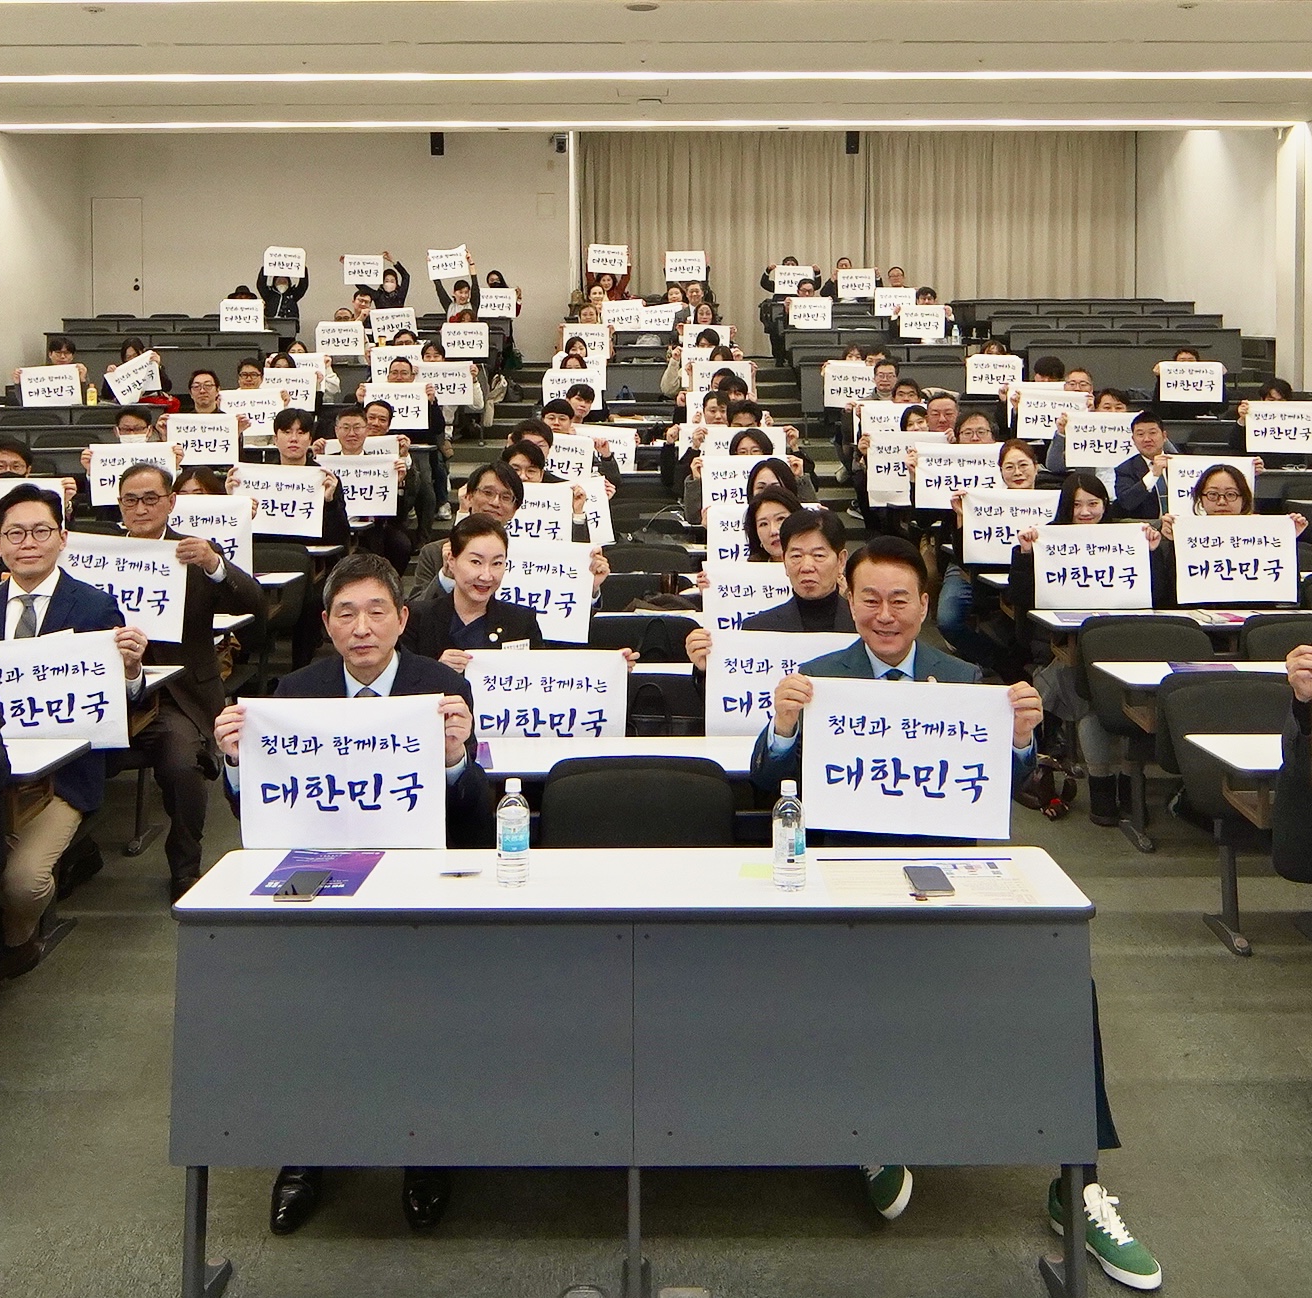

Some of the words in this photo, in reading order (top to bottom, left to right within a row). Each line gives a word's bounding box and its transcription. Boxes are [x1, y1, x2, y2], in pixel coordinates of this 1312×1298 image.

[1254, 427, 1311, 441] 대한민국
[1073, 439, 1132, 454] 대한민국
[545, 458, 584, 476] 한민국
[276, 482, 314, 493] 함께하는
[343, 485, 389, 500] 한민국
[712, 487, 748, 506] 대한
[261, 500, 314, 519] 한민국
[189, 515, 237, 527] 함께하는
[506, 518, 560, 538] 한민국
[974, 526, 1020, 545] 대한
[1188, 536, 1224, 548] 청년과
[1230, 536, 1281, 548] 함께하는
[1046, 544, 1080, 555] 청년과
[1086, 544, 1135, 555] 함께하는
[69, 554, 108, 569] 청년과
[116, 558, 170, 576] 함께하는
[522, 562, 577, 579] 함께하는
[1188, 559, 1283, 582] 대한민국
[1046, 566, 1138, 589] 대한민국
[97, 582, 169, 616] 민국
[718, 585, 756, 598] 청년과
[500, 587, 576, 618] 한민국
[33, 661, 105, 681] 함께하는
[725, 658, 773, 674] 청년과
[483, 676, 532, 691] 청년과
[541, 677, 607, 693] 함께하는
[9, 690, 109, 727] 한민국
[723, 691, 773, 721] 대한
[480, 707, 608, 737] 대한민국
[829, 716, 891, 737] 청년과
[902, 719, 988, 742] 함께하는
[261, 735, 323, 755] 청년과
[333, 734, 420, 755] 함께하는
[825, 757, 989, 803] 대한민국
[261, 772, 424, 812] 대한민국
